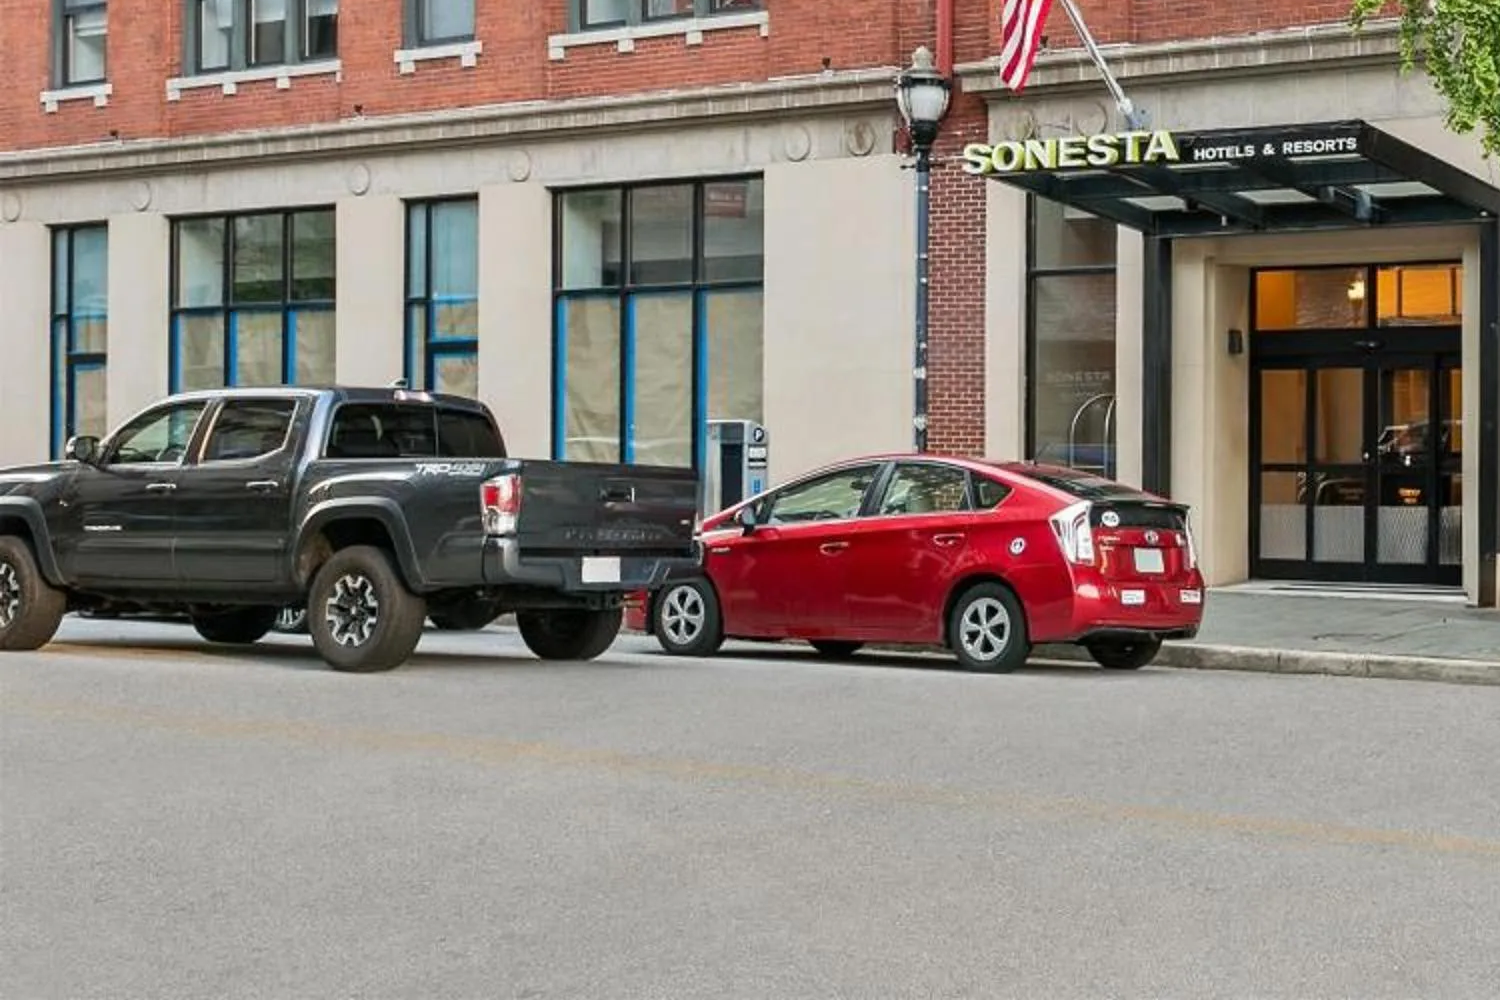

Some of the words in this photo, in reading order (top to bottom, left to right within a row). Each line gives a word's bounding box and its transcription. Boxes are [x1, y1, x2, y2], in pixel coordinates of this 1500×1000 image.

[963, 130, 1179, 174] SONESTA
[1194, 145, 1255, 161] HOTELS
[1263, 143, 1275, 155] &
[1283, 137, 1357, 154] RESORTS
